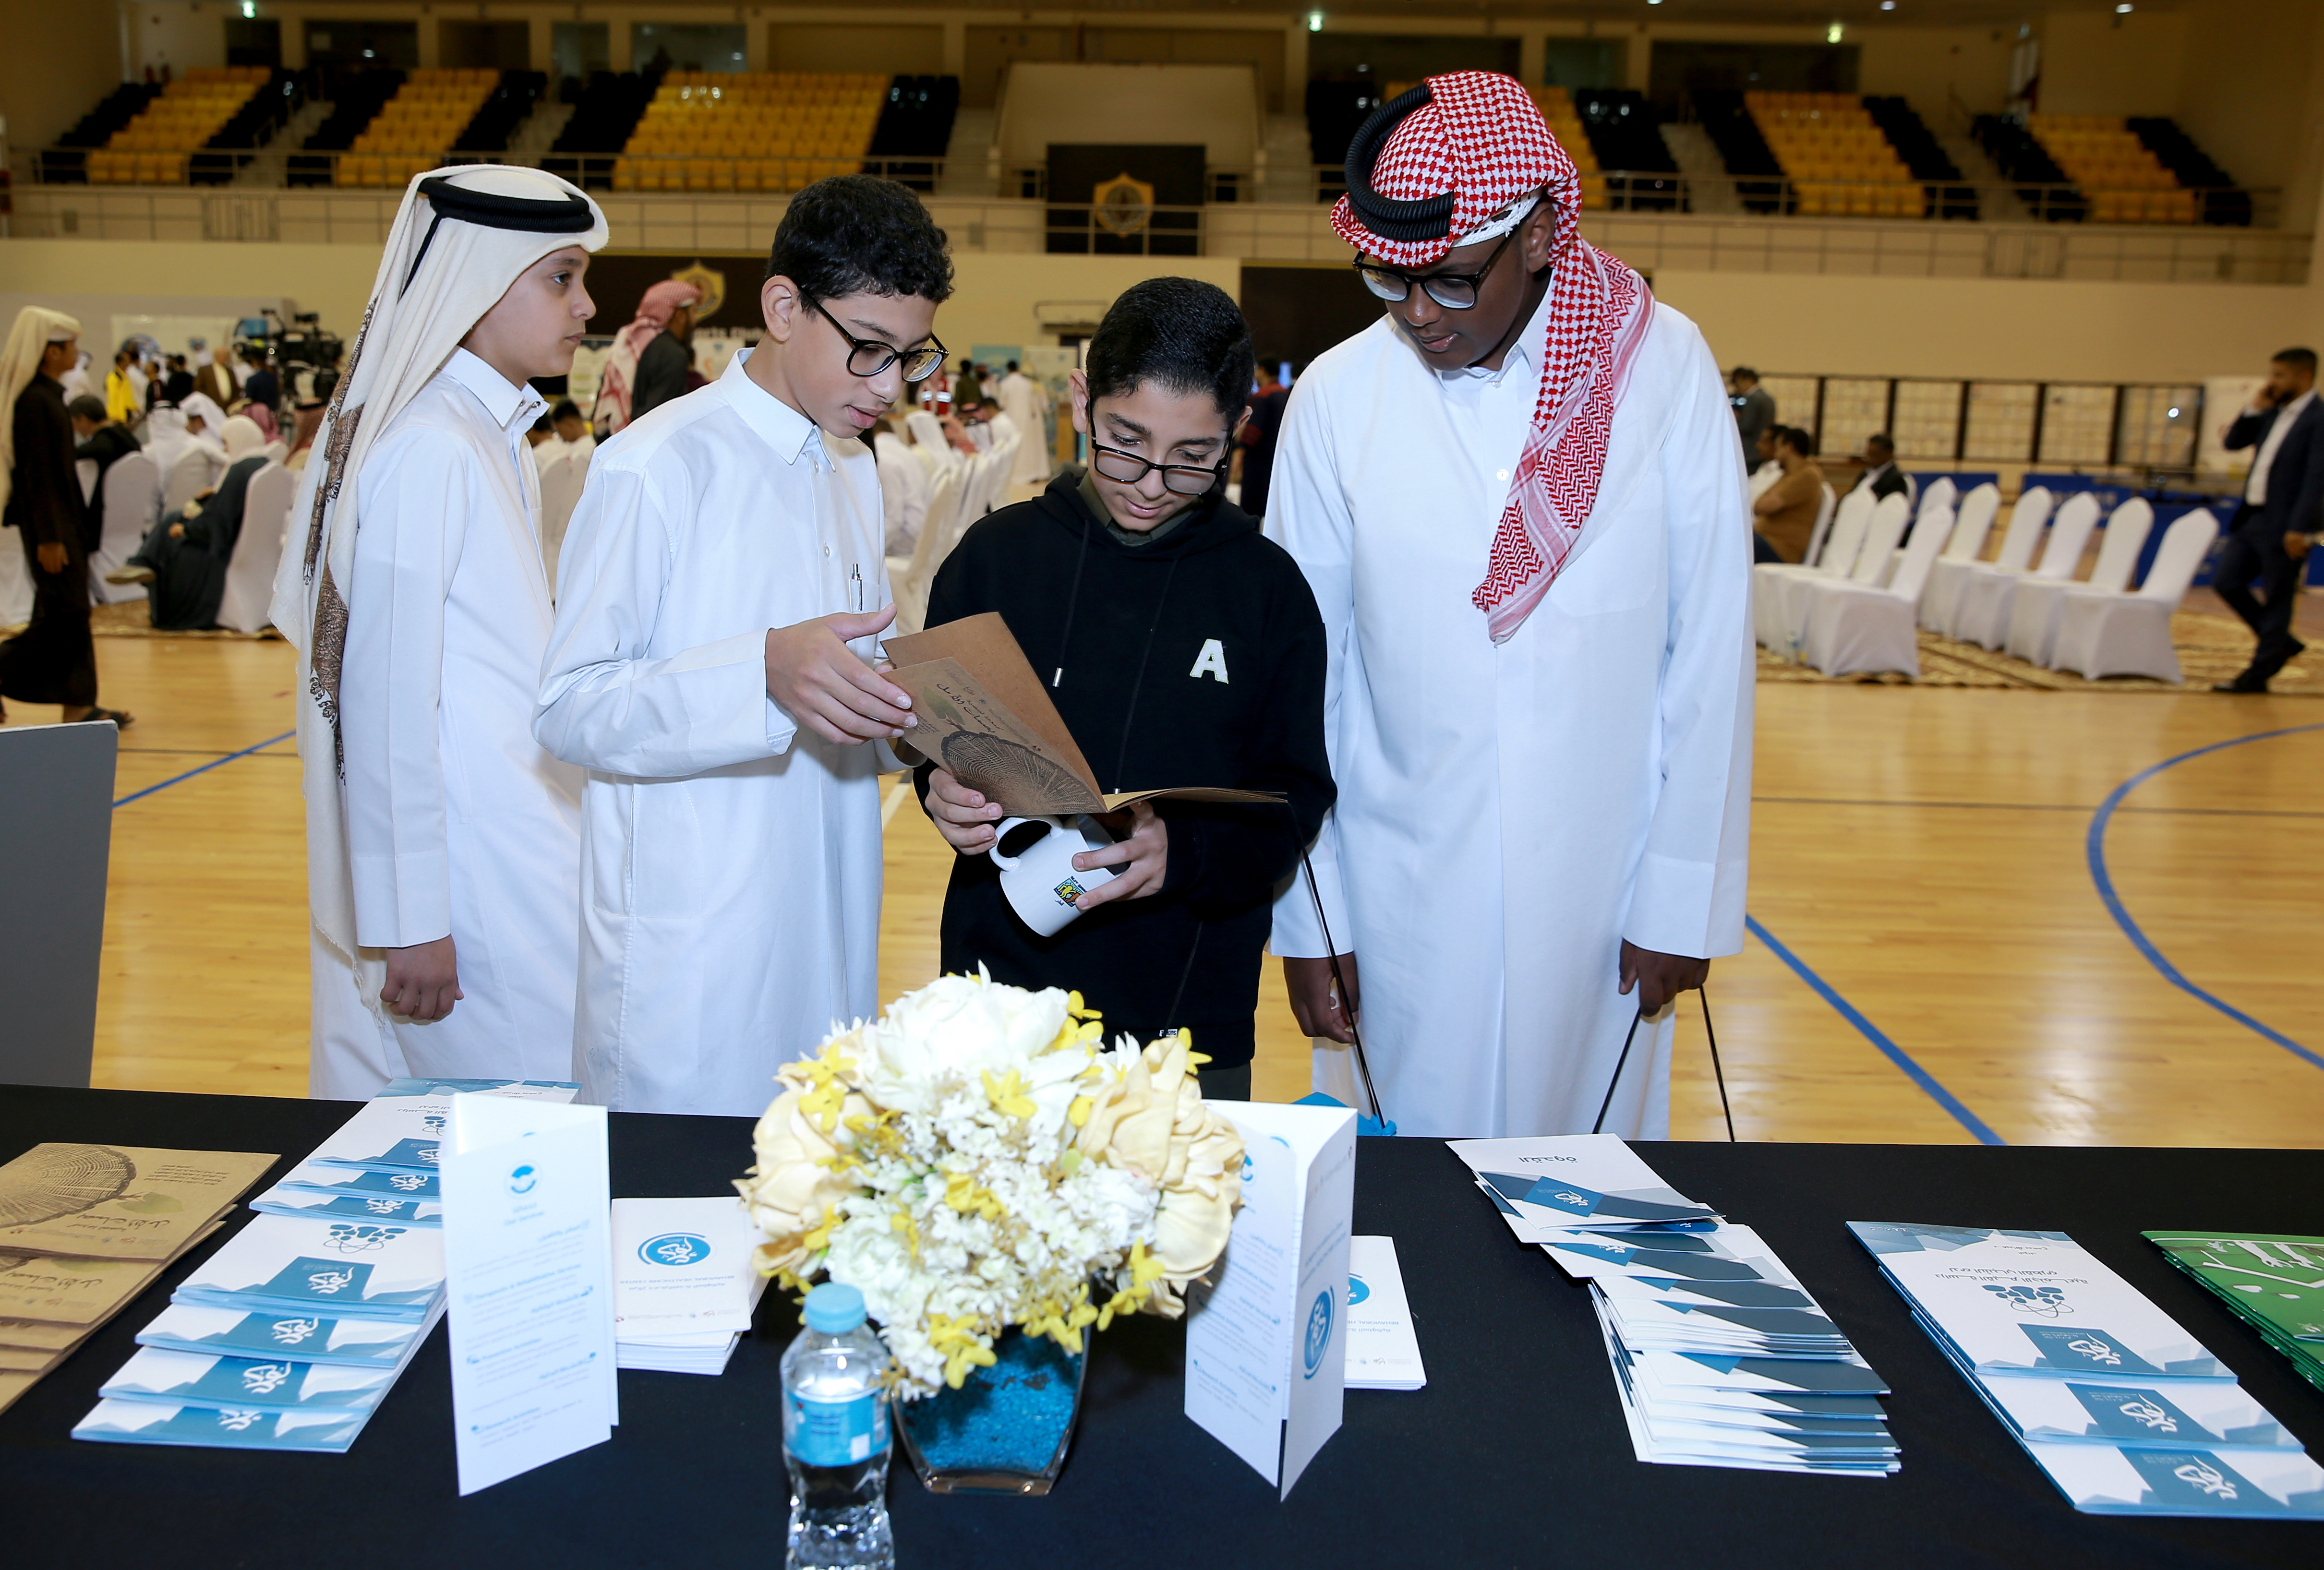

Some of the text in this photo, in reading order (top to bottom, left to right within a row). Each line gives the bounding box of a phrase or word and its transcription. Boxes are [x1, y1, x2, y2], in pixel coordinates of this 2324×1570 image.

[1189, 638, 1229, 684] A
[1517, 1155, 1578, 1164] القدوة
[2021, 1276, 2089, 1285] الاجتماعية
